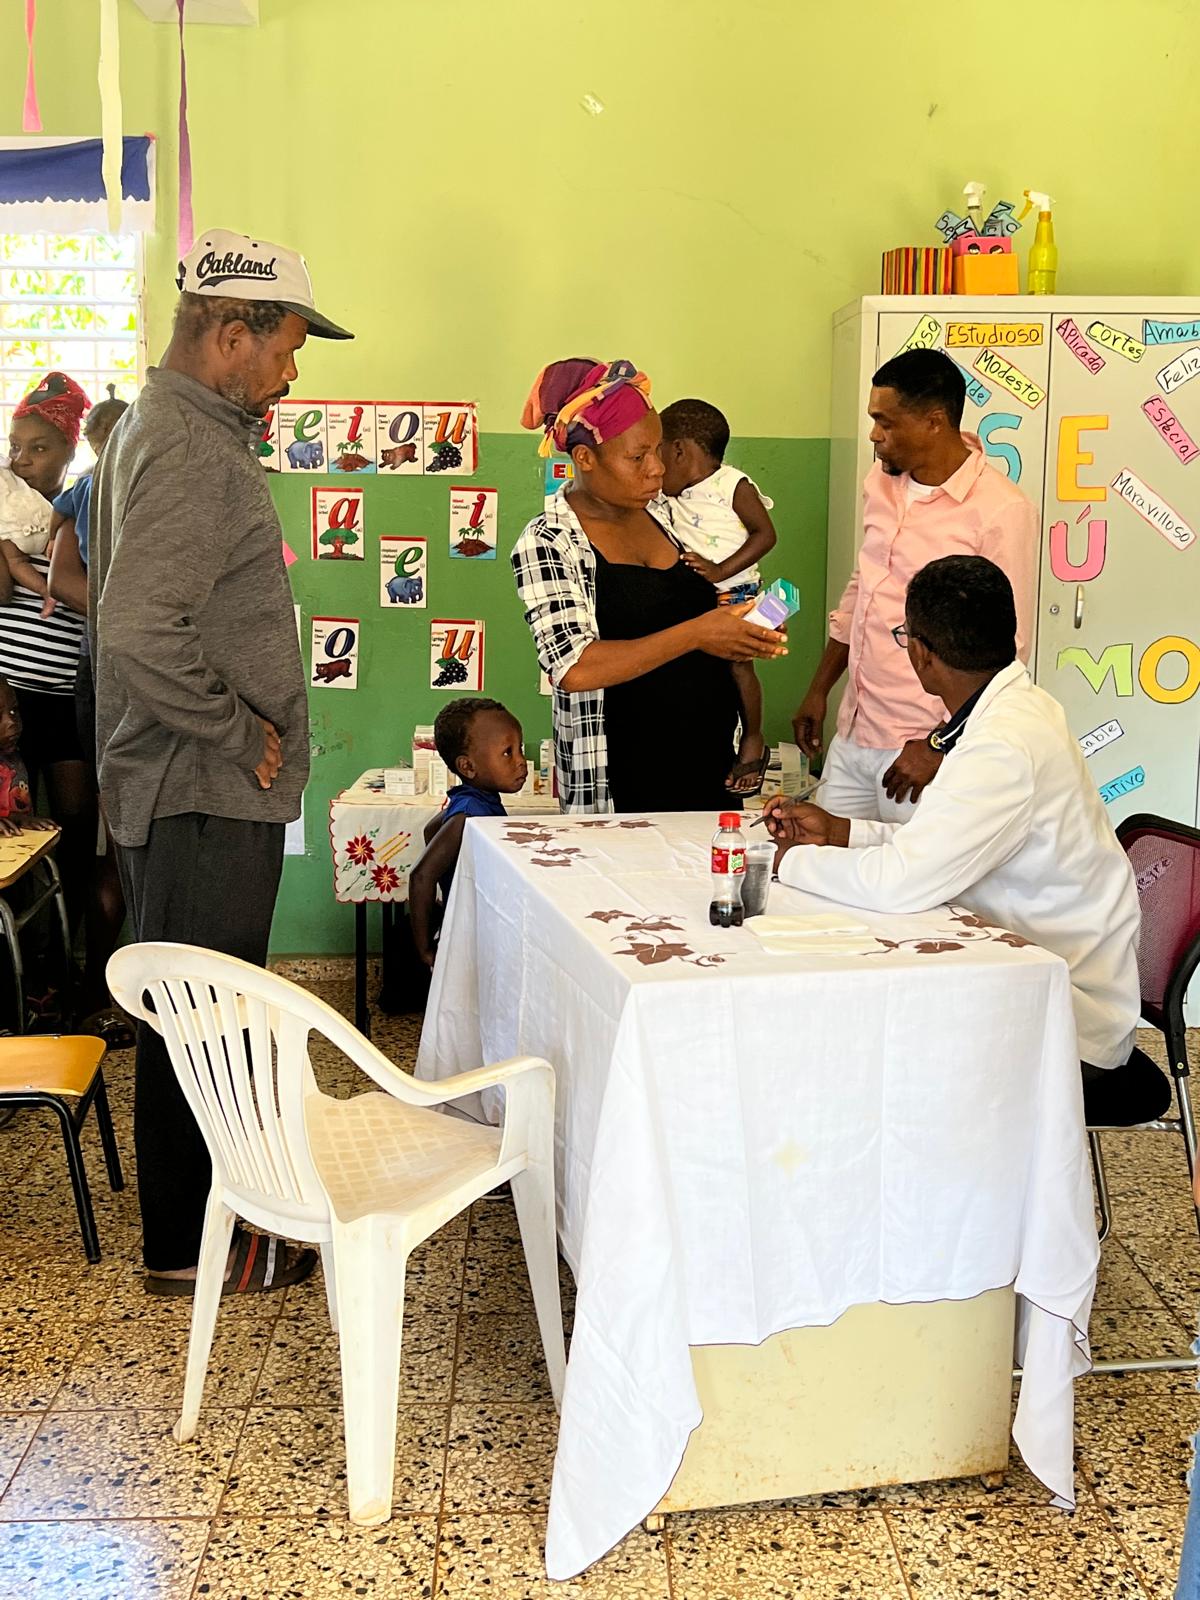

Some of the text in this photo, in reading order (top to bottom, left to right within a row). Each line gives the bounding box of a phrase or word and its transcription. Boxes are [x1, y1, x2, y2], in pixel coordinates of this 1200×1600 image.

[196, 251, 277, 279] Oakland
[1087, 321, 1142, 359] Cortes
[975, 350, 1040, 403] Modesto
[1162, 358, 1200, 390] Feliz
[294, 410, 323, 442] e
[347, 406, 364, 442] i
[389, 411, 419, 443] o
[435, 412, 468, 444] u
[328, 497, 360, 530] a
[469, 493, 487, 528] i
[394, 547, 423, 577] e
[325, 627, 355, 658] o
[442, 629, 475, 660] u
